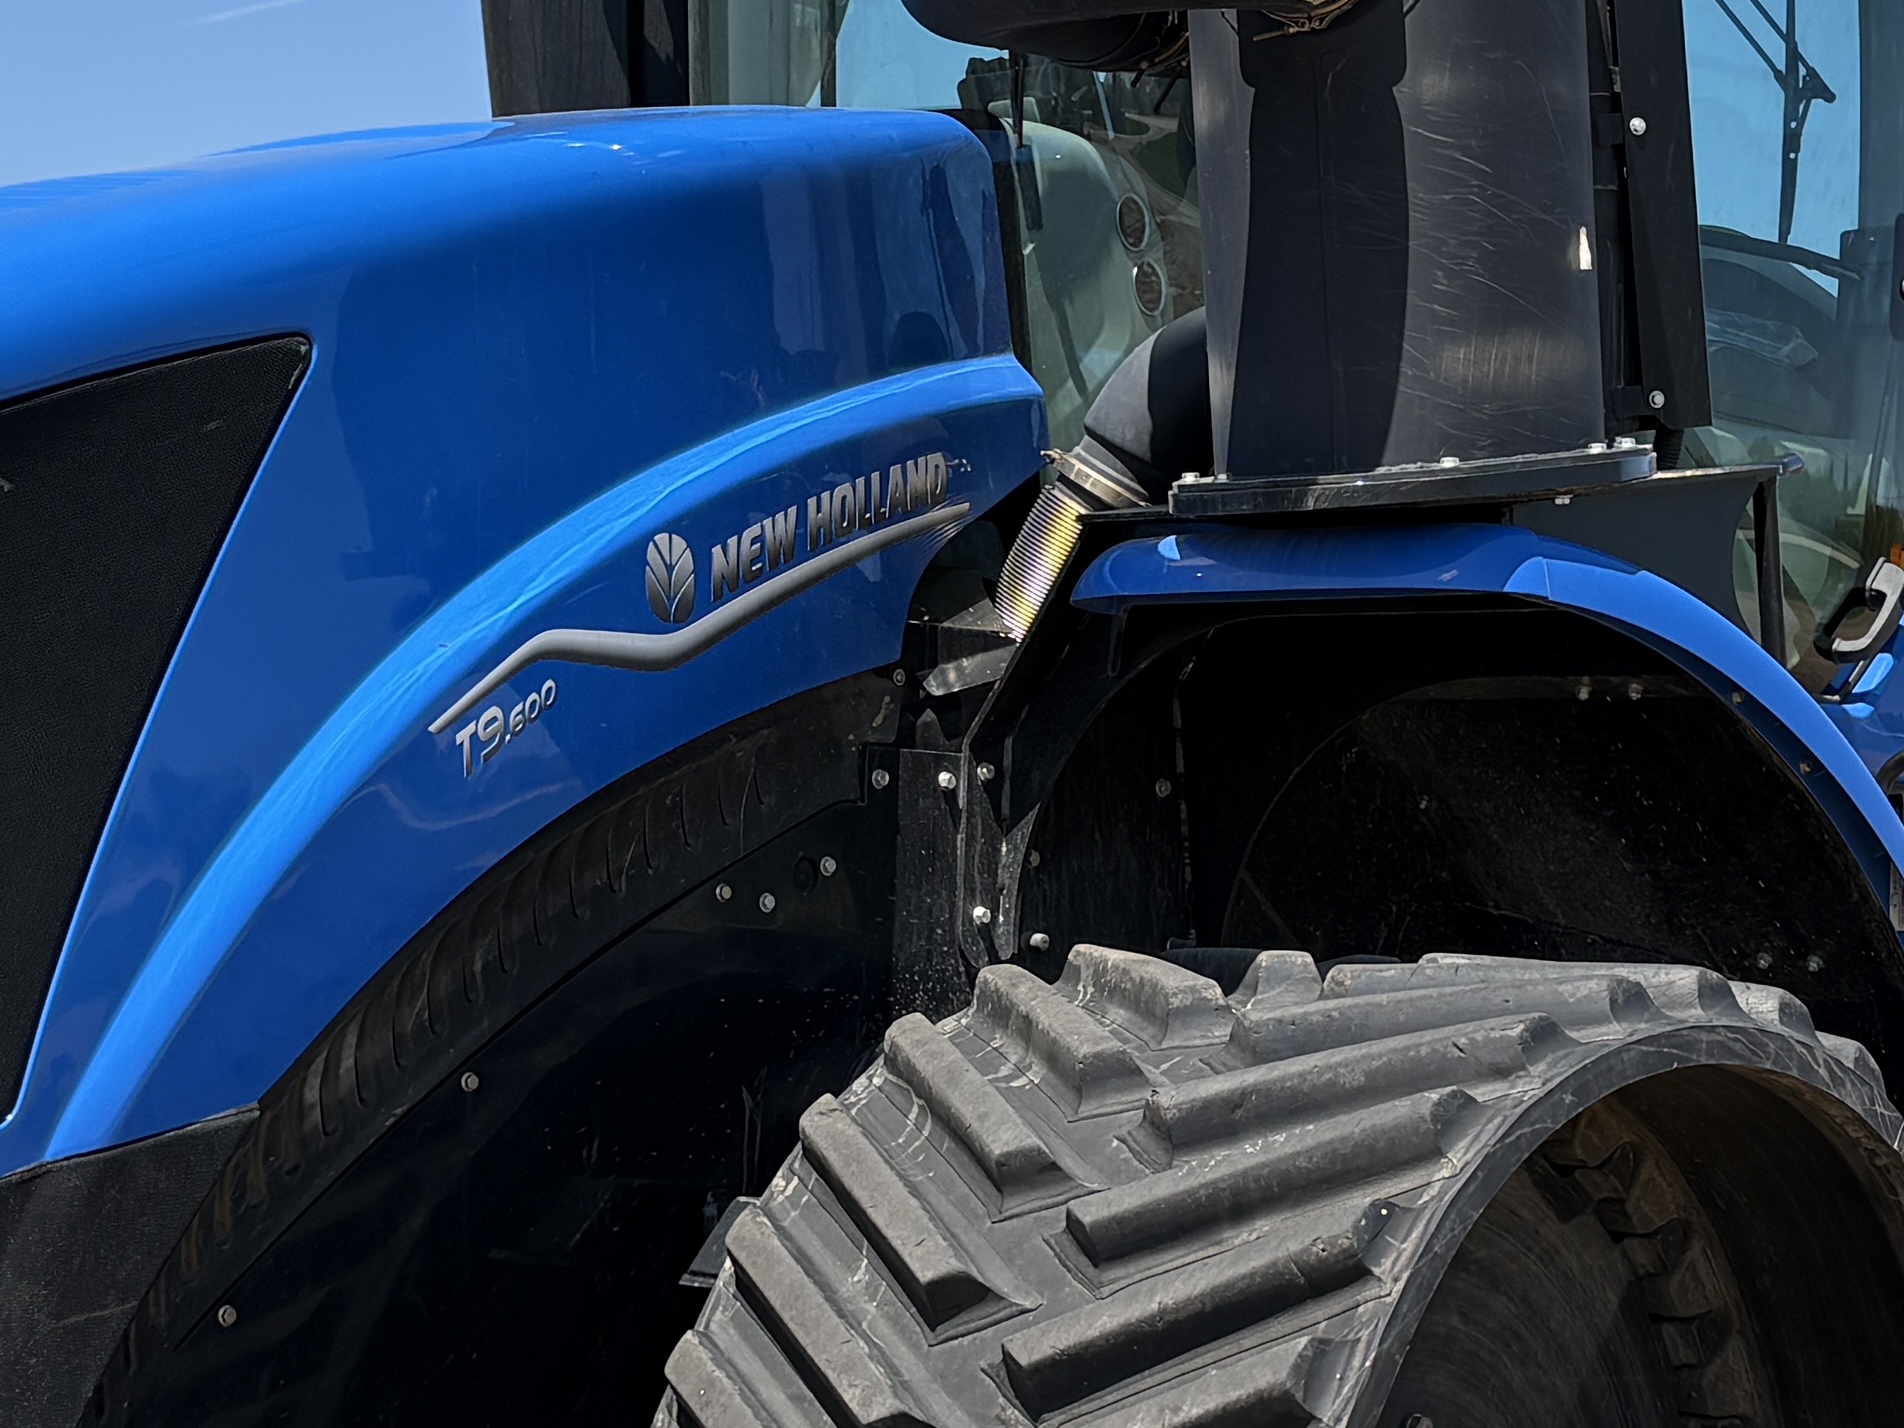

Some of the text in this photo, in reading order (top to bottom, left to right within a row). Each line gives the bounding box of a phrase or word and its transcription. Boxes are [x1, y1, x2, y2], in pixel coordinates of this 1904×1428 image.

[710, 451, 948, 603] NEW HOLLAND
[455, 678, 557, 779] T9.600
